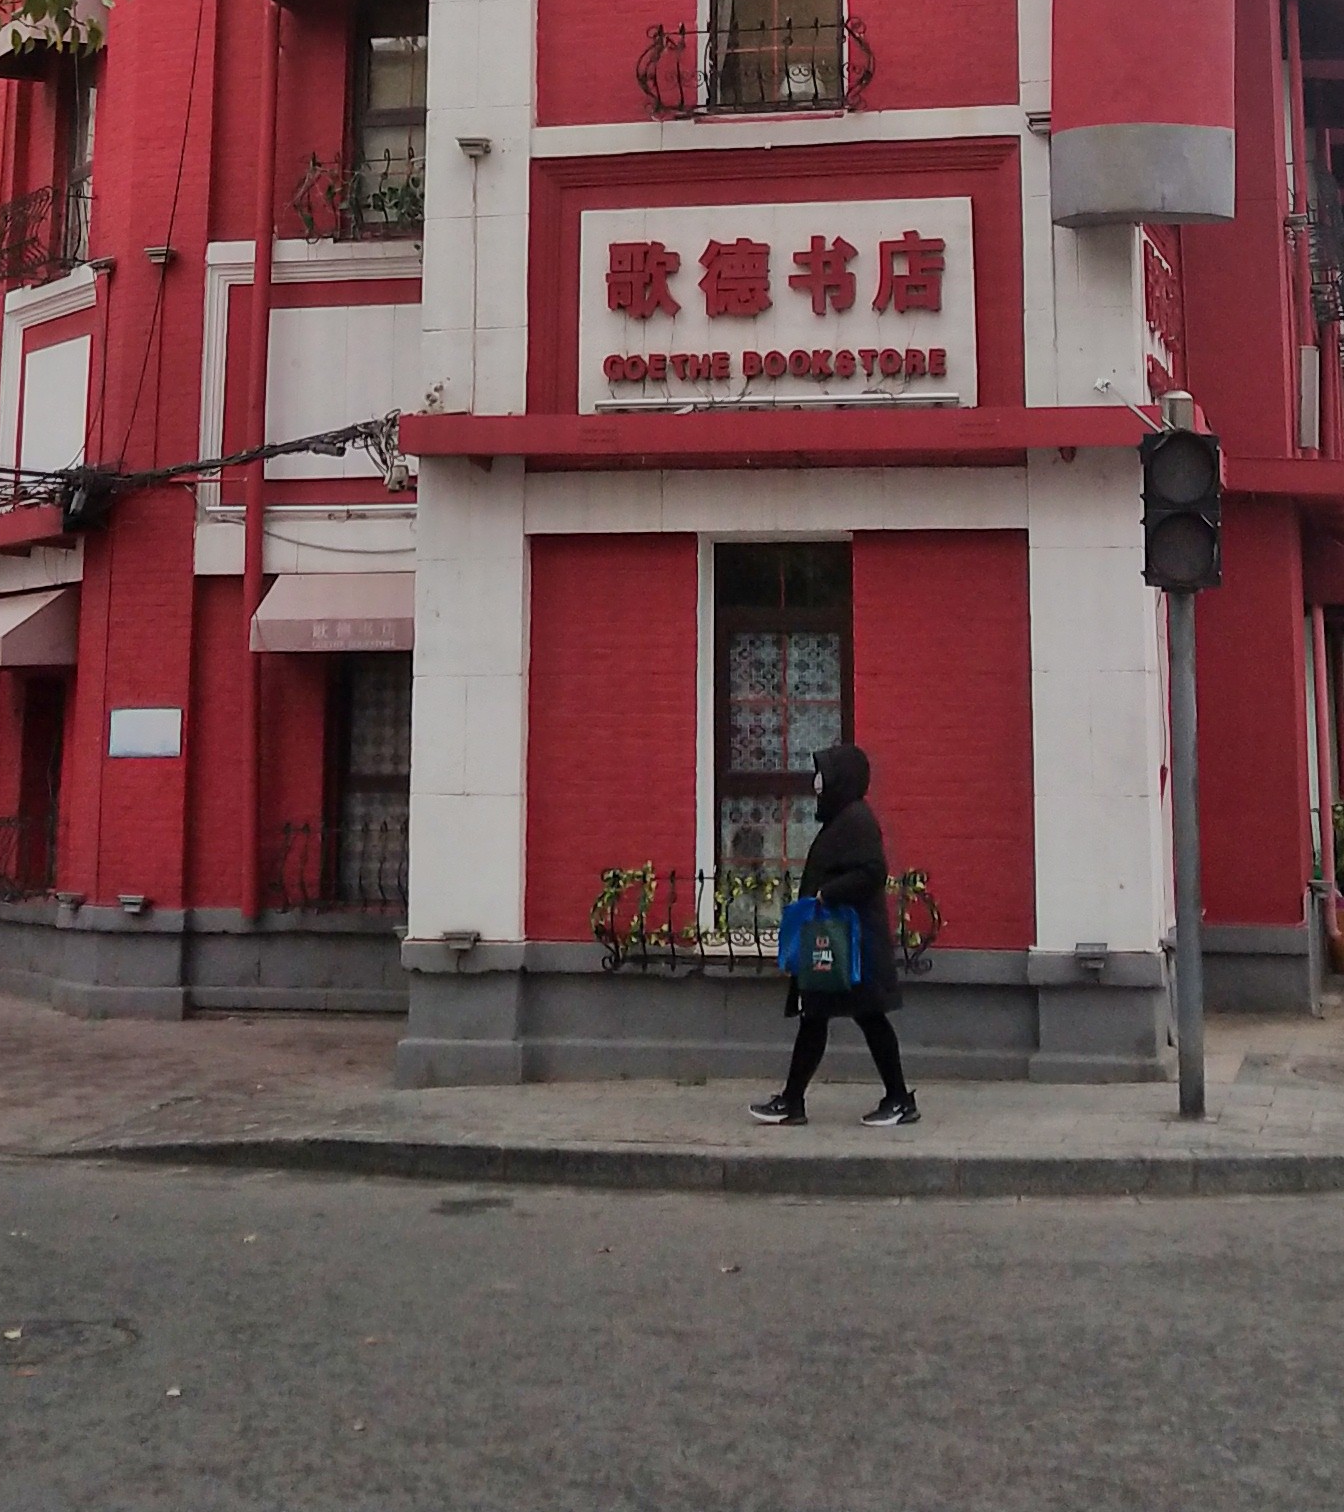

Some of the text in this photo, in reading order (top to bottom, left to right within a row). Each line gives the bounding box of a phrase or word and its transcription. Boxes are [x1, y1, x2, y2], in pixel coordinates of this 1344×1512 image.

[605, 230, 947, 319] 歌德书店
[603, 348, 947, 382] GOETHE BOOKSTORE
